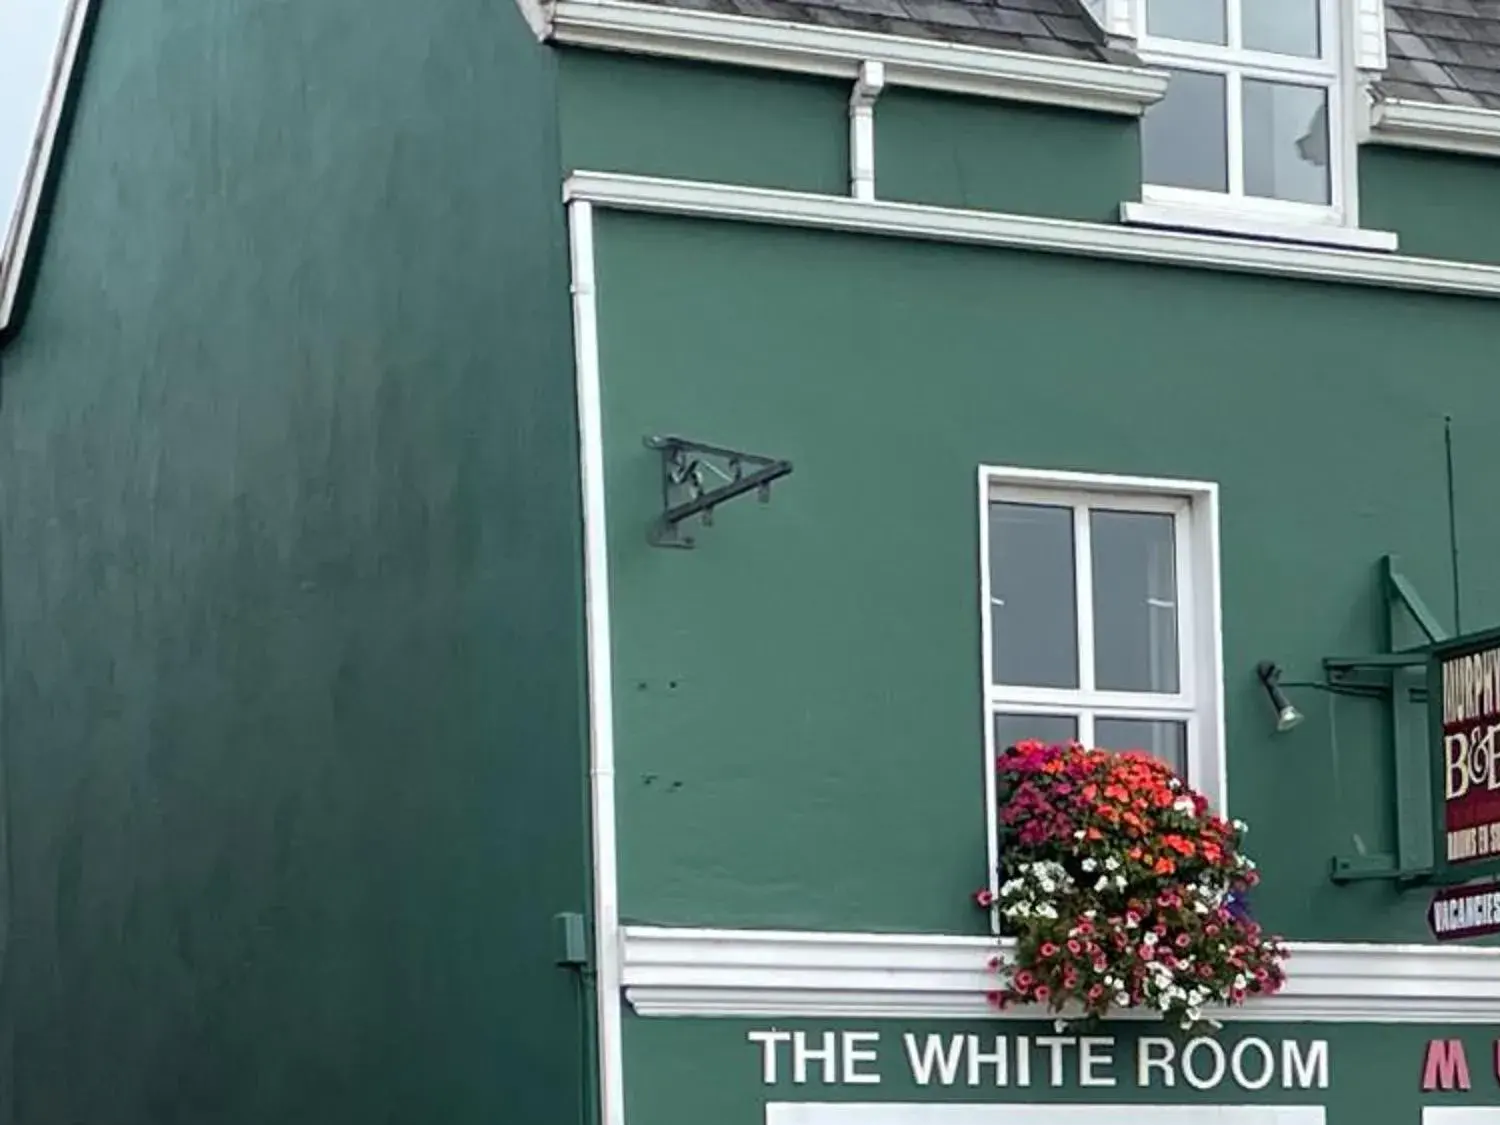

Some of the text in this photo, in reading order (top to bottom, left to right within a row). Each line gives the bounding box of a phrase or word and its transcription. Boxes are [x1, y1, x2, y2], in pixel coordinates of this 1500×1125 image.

[748, 1030, 1330, 1089] THE WHITE ROOM
